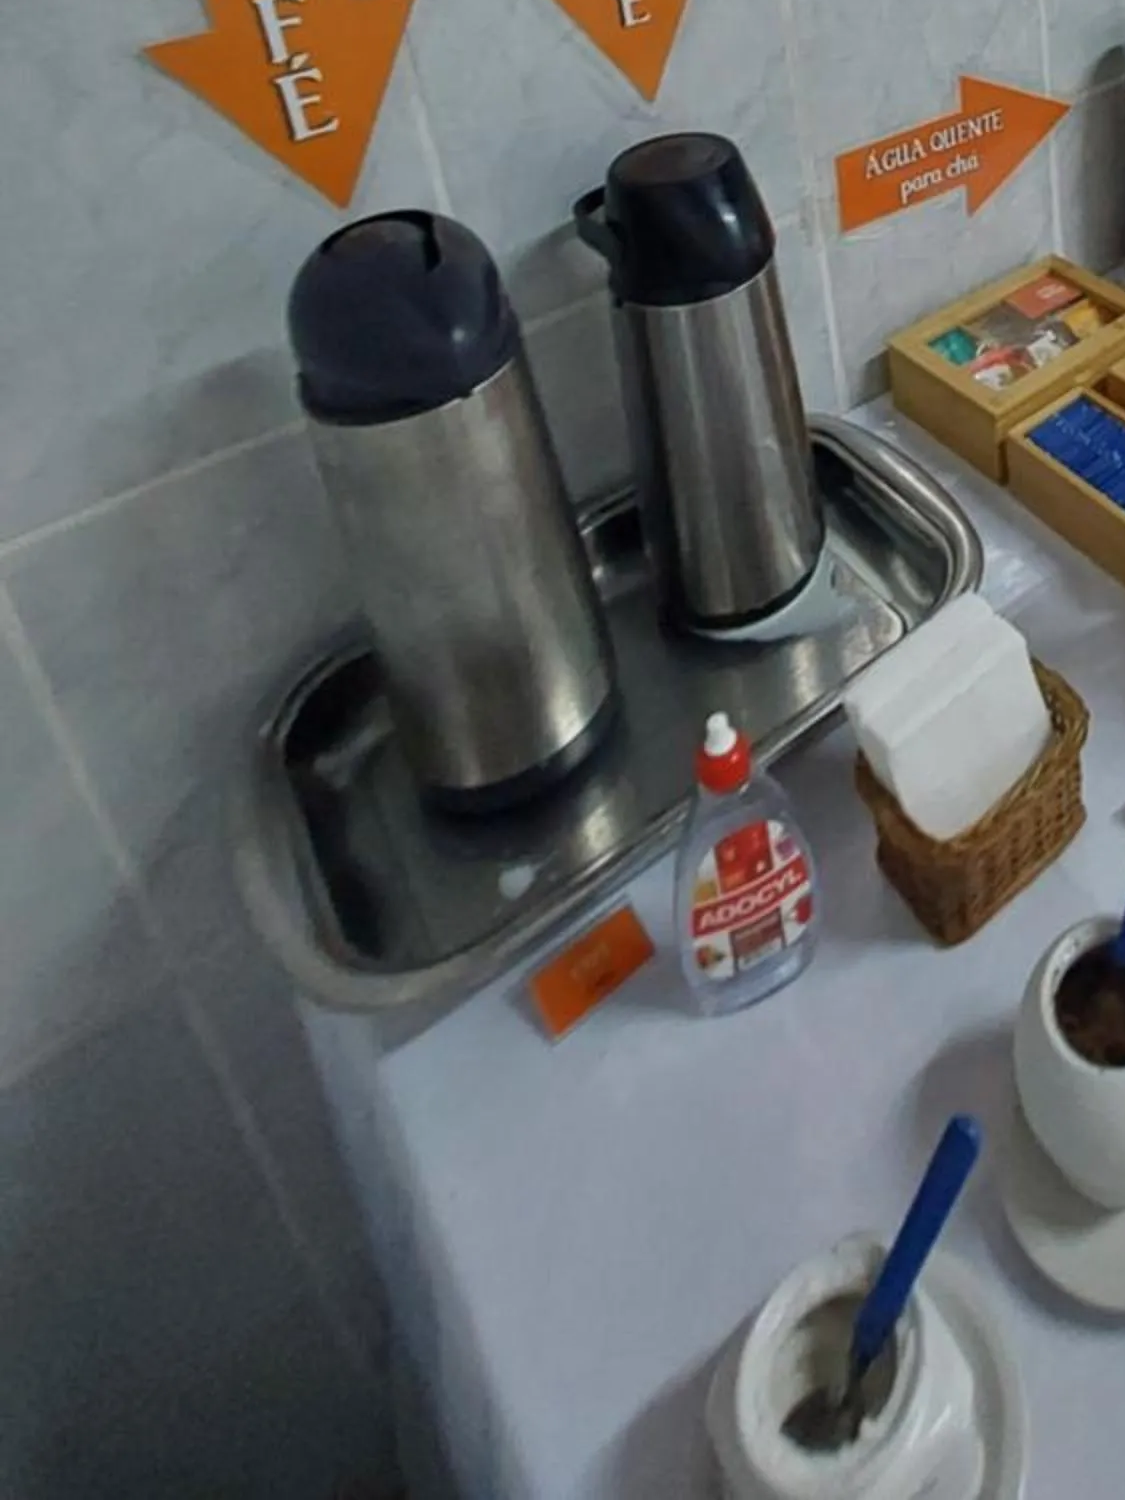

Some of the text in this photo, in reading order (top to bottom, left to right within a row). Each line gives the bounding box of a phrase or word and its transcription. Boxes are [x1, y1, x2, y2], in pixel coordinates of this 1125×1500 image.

[864, 107, 1005, 181] ÁGUA QUENTE
[899, 148, 981, 206] para chá
[698, 867, 805, 932] ADOCYL
